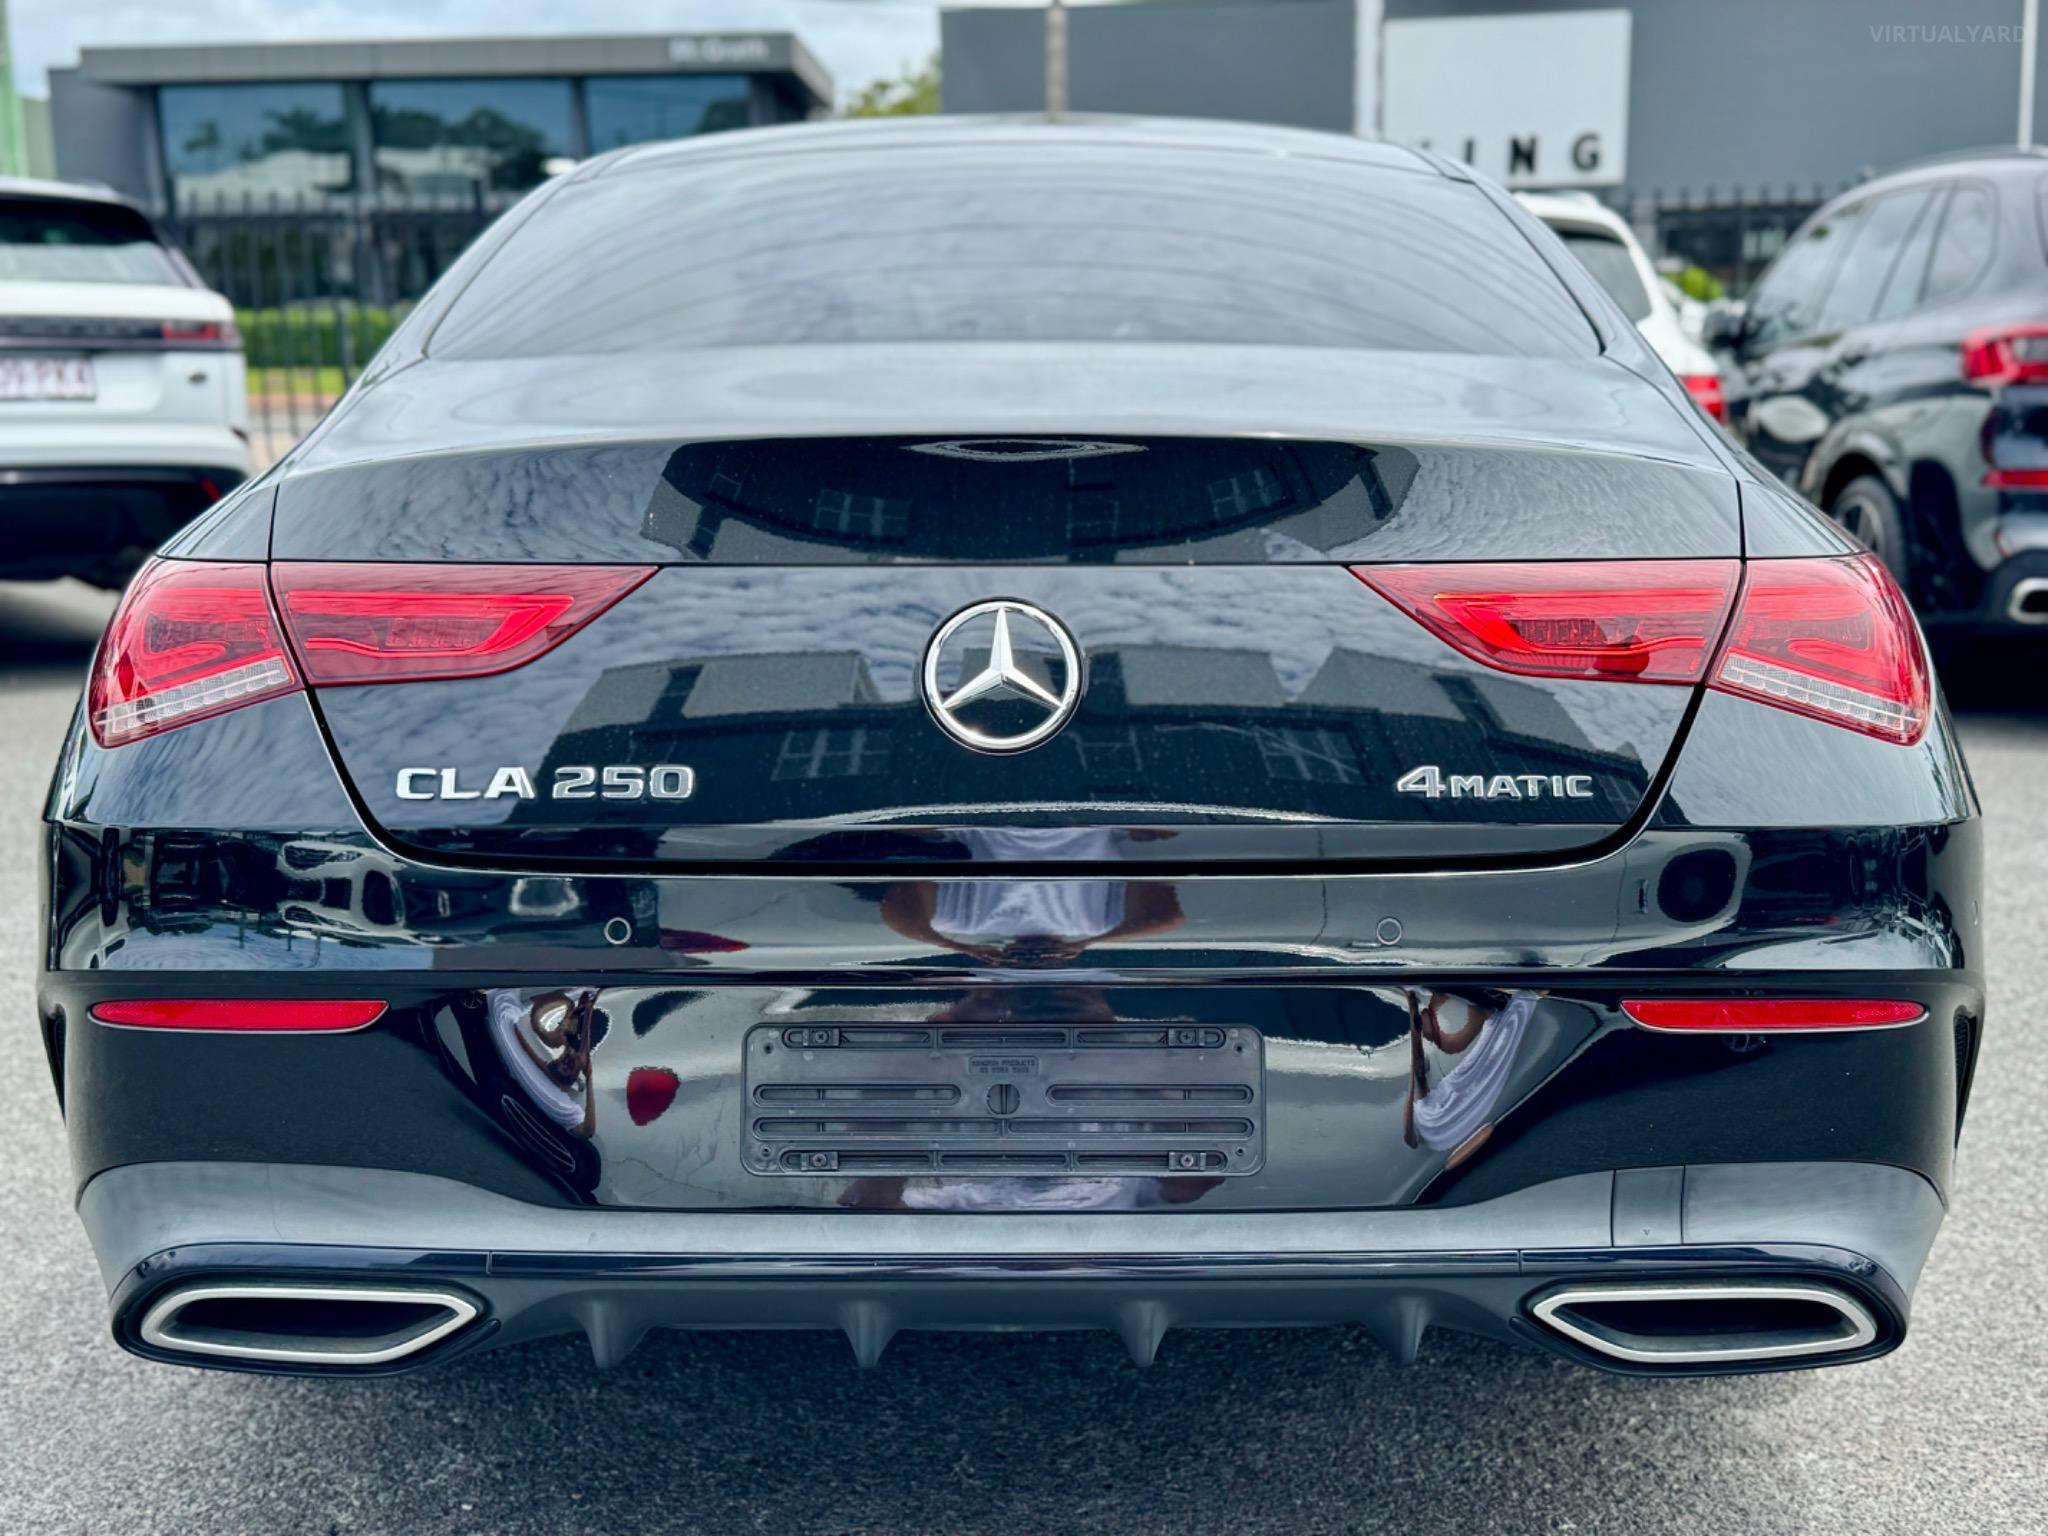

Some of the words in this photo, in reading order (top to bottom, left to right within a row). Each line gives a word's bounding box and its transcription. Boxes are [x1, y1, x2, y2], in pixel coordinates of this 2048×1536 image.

[1419, 132, 1600, 174] ING
[395, 767, 535, 800] CLA
[552, 766, 695, 799] 250
[1397, 765, 1594, 798] 4MATIC
